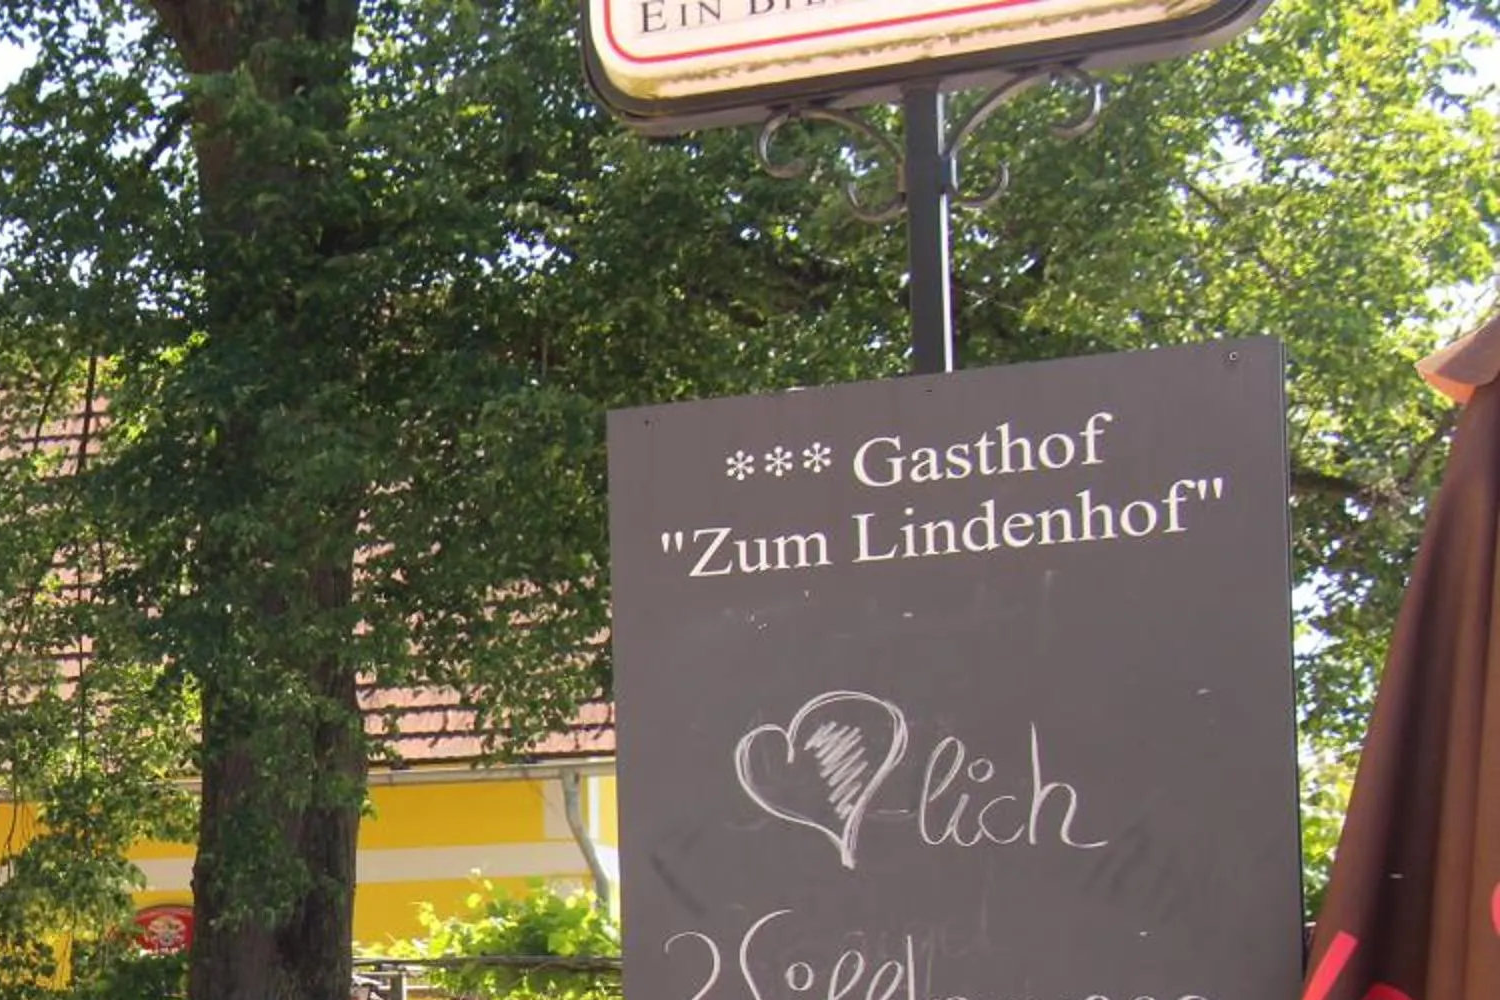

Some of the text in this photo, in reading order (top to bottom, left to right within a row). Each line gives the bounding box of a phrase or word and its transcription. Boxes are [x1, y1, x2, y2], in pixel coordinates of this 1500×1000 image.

[853, 412, 1113, 488] Gasthof
[661, 477, 1225, 578] "Zum Lindenhof"
[918, 722, 1108, 847] lich
